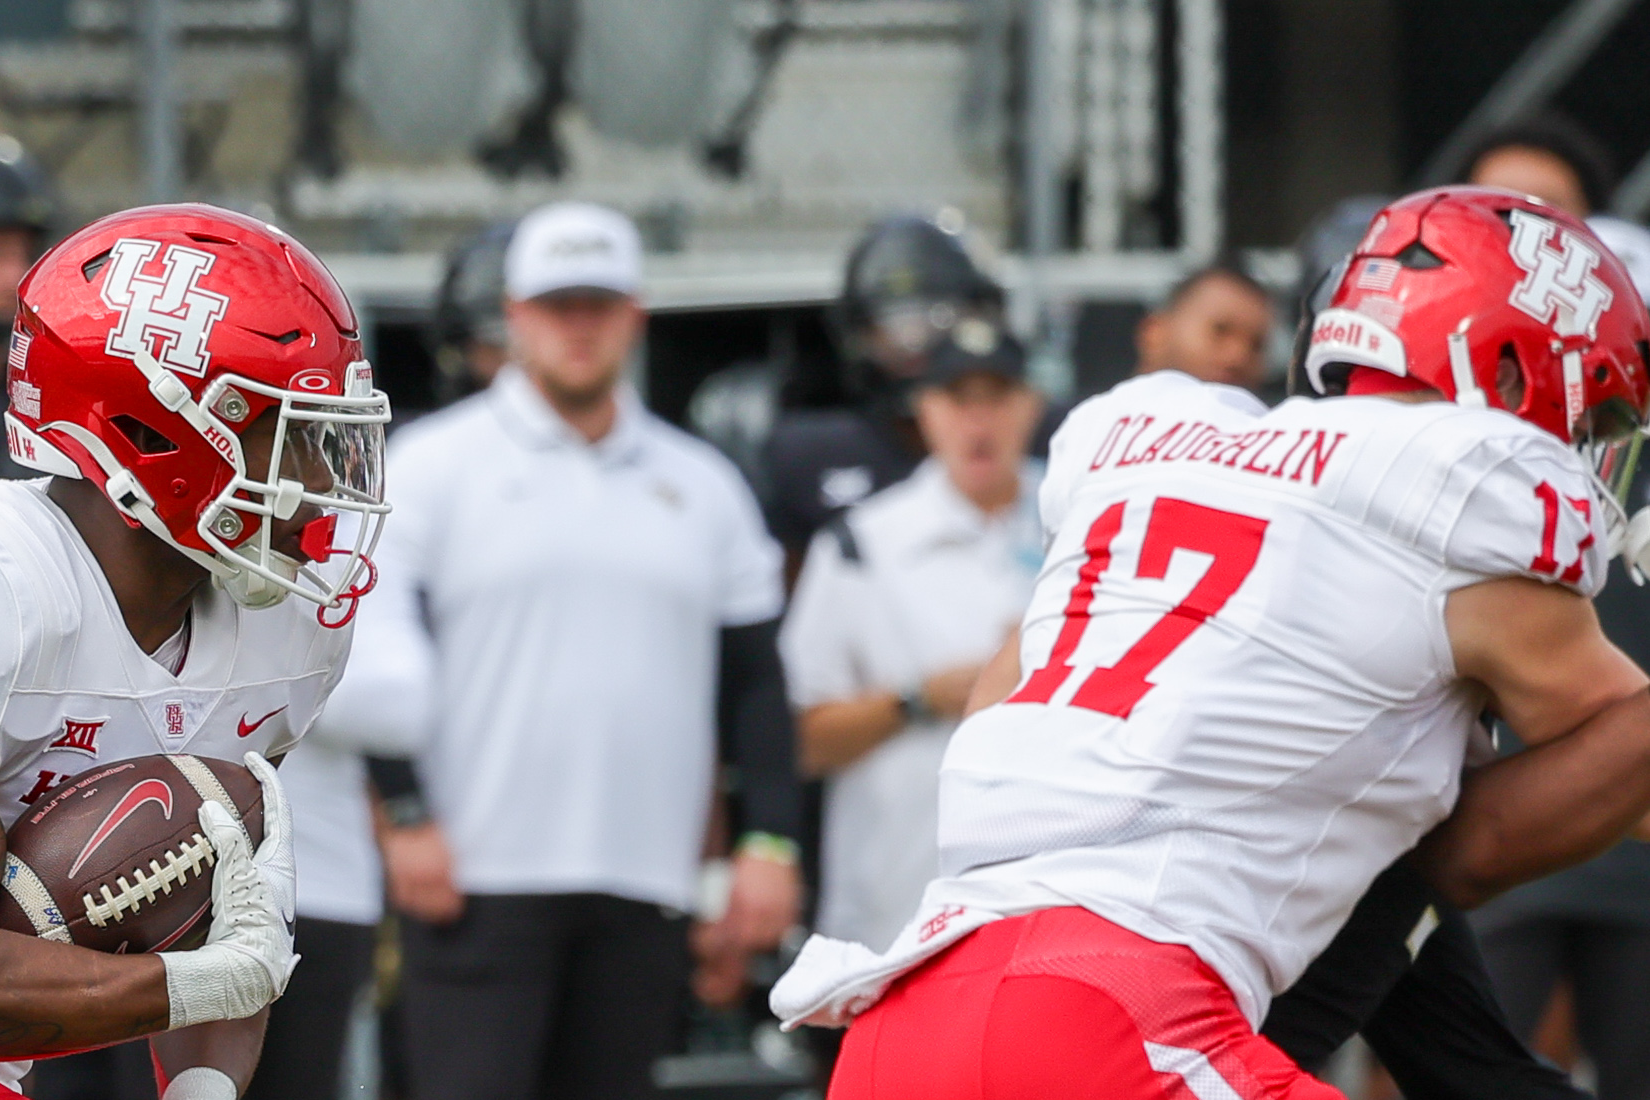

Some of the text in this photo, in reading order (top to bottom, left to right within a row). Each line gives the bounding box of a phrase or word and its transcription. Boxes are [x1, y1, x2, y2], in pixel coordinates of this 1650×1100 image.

[100, 238, 230, 379] UH
[1508, 208, 1614, 342] UH
[1088, 414, 1349, 487] O'LAUGHLIN
[1530, 480, 1596, 584] 17
[1002, 496, 1272, 721] 17
[50, 719, 108, 754] XII
